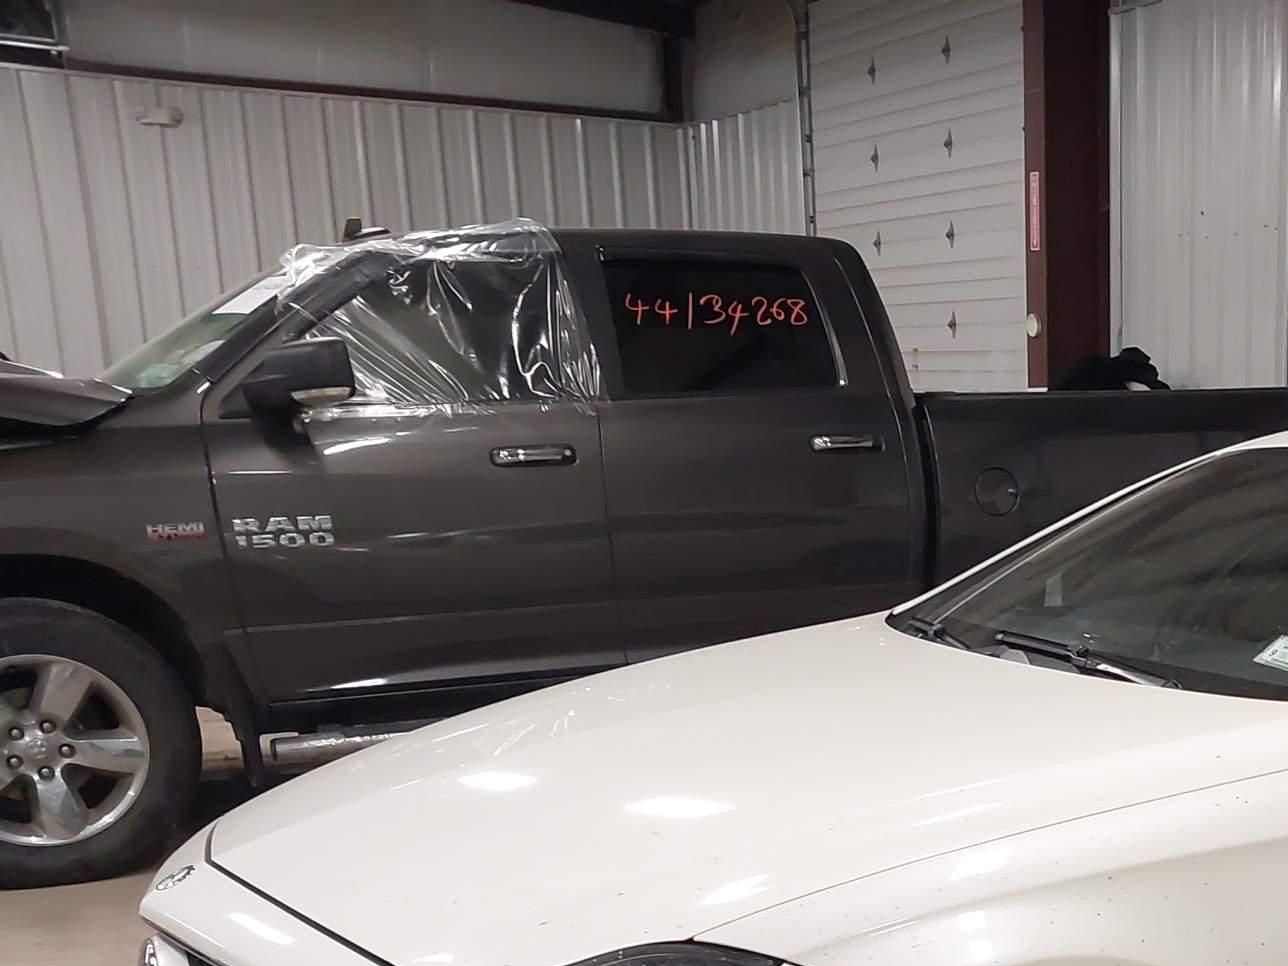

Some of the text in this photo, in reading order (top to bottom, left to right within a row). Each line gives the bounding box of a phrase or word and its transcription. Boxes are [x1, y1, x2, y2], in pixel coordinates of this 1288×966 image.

[624, 292, 808, 336] 44134268
[146, 522, 205, 536] HEMI
[232, 515, 333, 532] RAM
[235, 531, 335, 548] 1500
